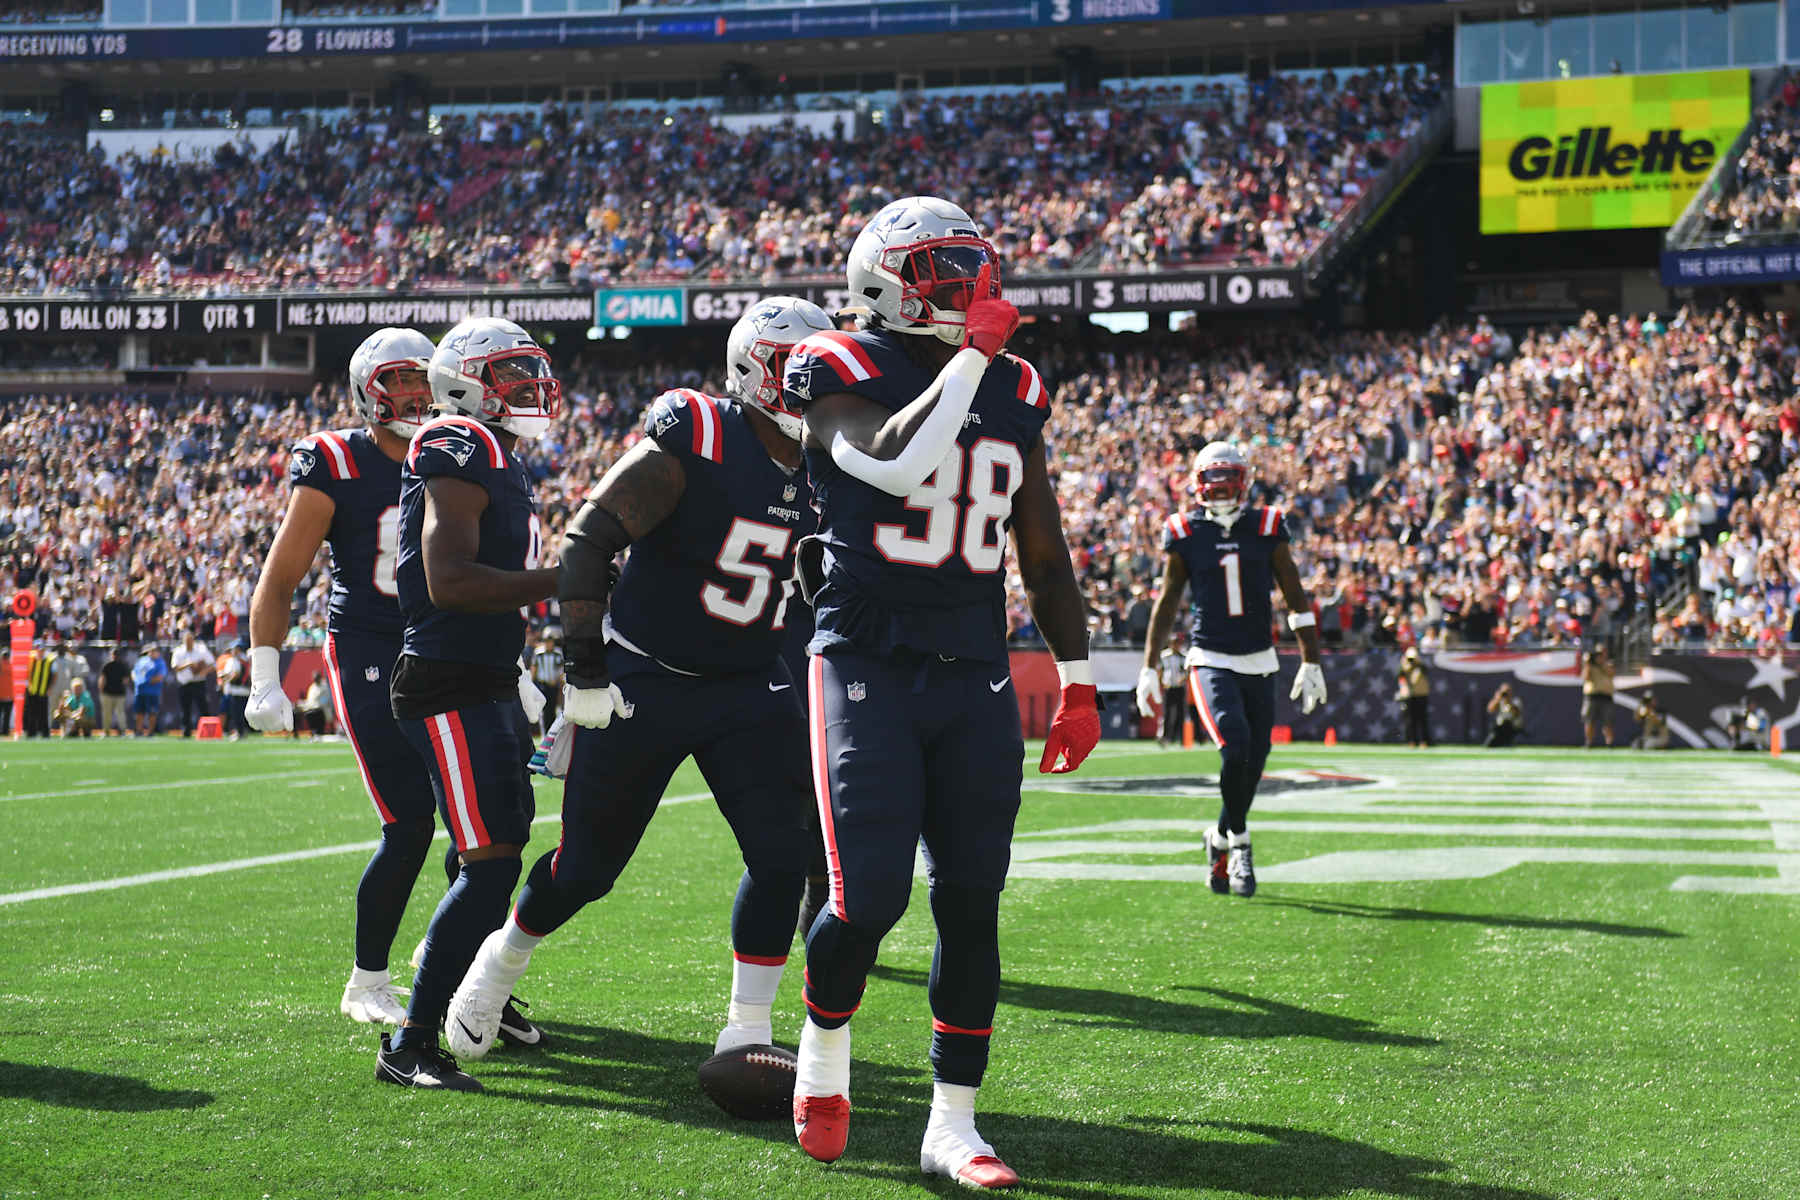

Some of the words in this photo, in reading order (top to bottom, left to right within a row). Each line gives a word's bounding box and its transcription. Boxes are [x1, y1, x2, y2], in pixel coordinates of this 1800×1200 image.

[92, 33, 128, 56] YDS
[266, 28, 303, 53] 28
[315, 28, 395, 51] FLOWERS
[1508, 127, 1716, 182] Gillette
[1679, 257, 1704, 277] THE
[1093, 281, 1115, 309] 3
[1149, 281, 1207, 303] DOWNS
[1227, 275, 1253, 305] 0
[14, 306, 40, 331] 10
[60, 305, 101, 331] BALL
[104, 305, 131, 330] ON
[135, 305, 168, 330] 33
[203, 303, 238, 333] QTR
[243, 303, 255, 329] 1
[314, 302, 326, 326] 2
[326, 302, 367, 325] YARD
[368, 301, 448, 325] RECEPTION
[630, 294, 678, 320] MIA
[872, 435, 1023, 574] 38
[1219, 552, 1244, 618] 1
